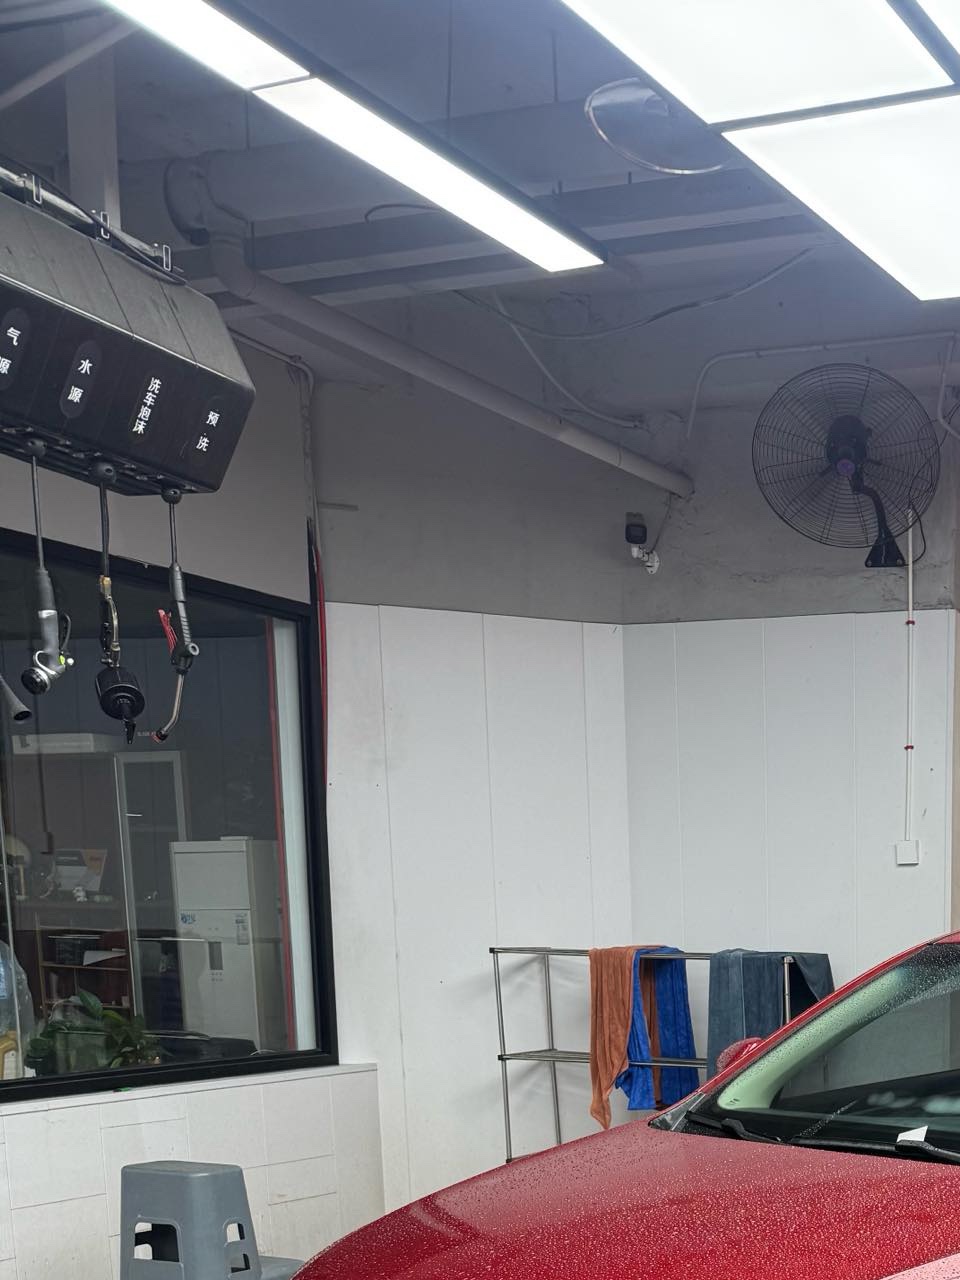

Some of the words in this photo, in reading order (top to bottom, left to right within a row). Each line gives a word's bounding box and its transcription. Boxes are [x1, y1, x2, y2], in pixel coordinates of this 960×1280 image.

[0, 327, 22, 374] 气源
[67, 358, 93, 404] 水源
[132, 377, 162, 434] 洗车泡沫
[196, 410, 220, 451] 预洗
